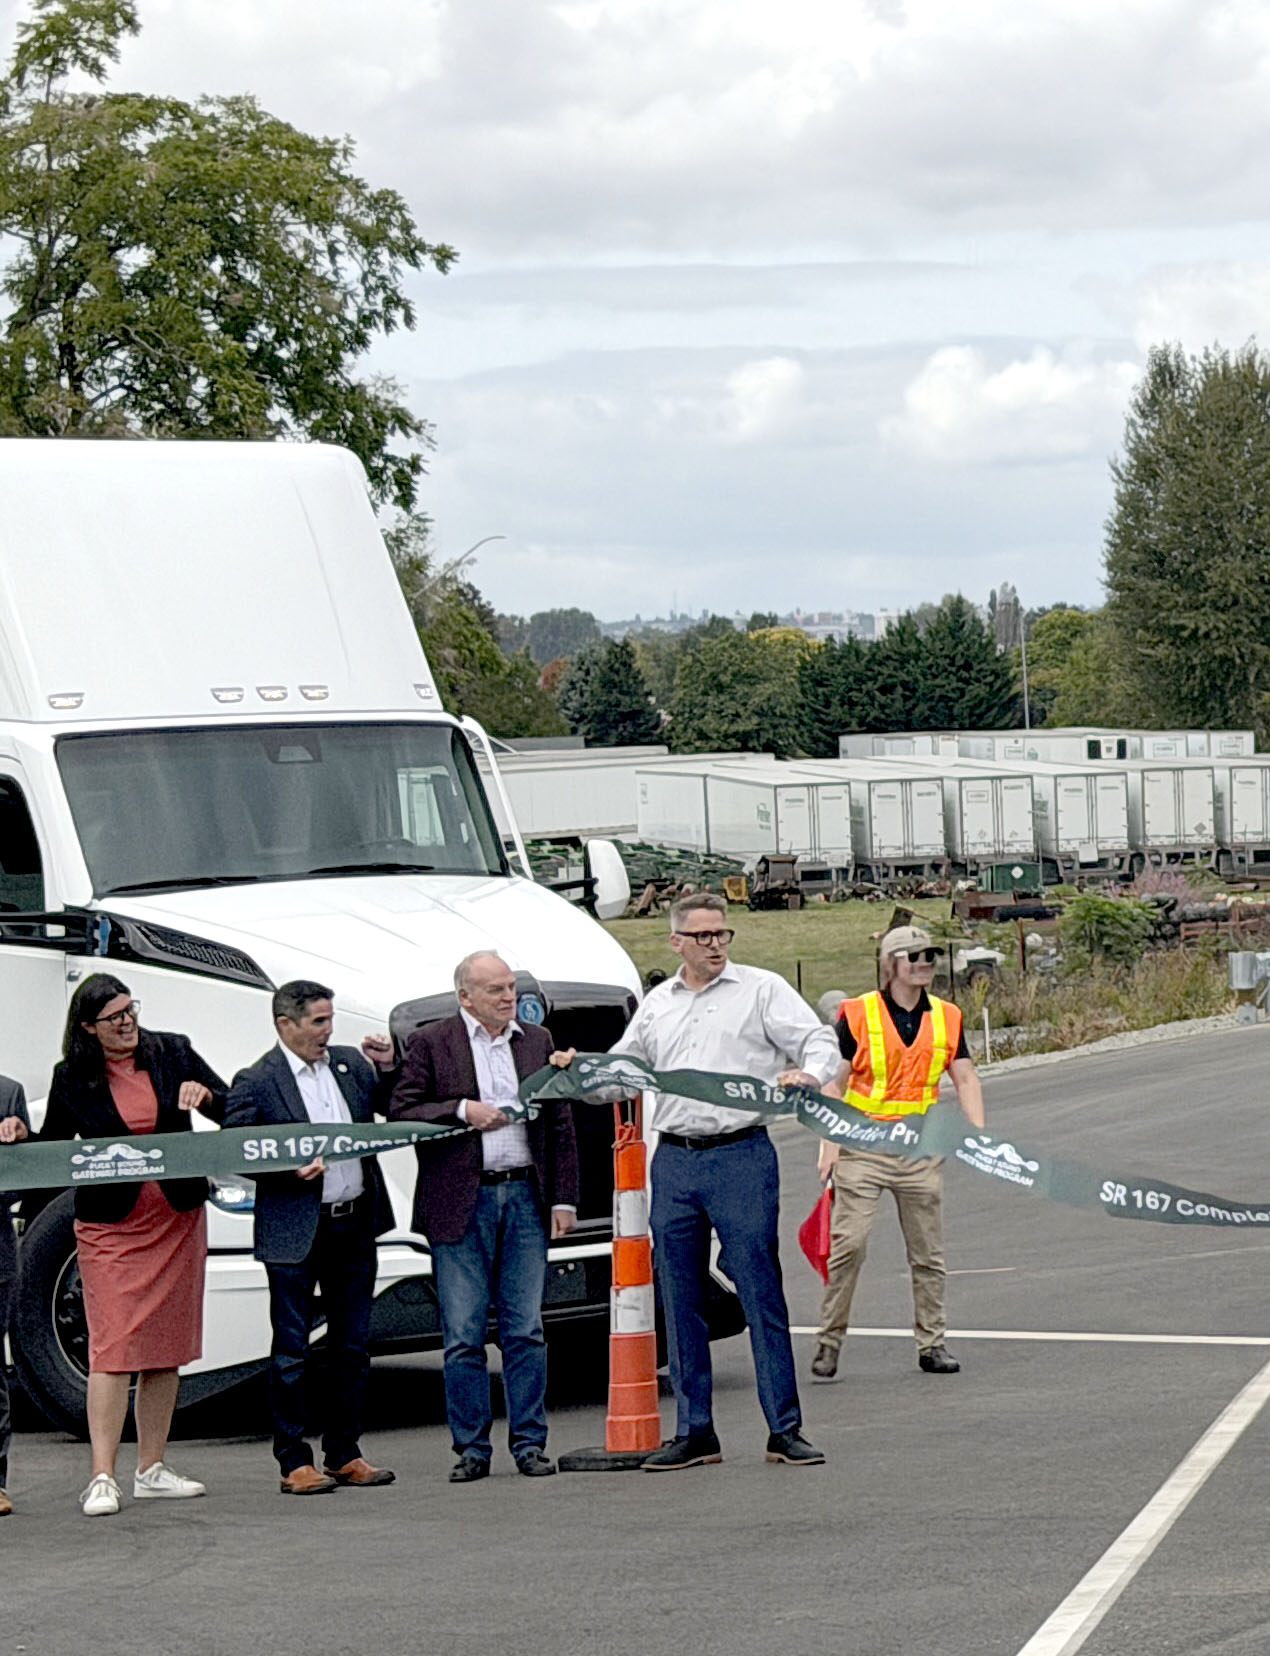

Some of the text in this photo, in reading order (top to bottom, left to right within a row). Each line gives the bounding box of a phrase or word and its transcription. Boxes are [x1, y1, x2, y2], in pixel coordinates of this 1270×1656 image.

[723, 1081, 757, 1101] SR
[242, 1139, 279, 1161] SR
[284, 1135, 328, 1158] 167
[1100, 1180, 1127, 1206] SR
[1132, 1189, 1171, 1210] 167
